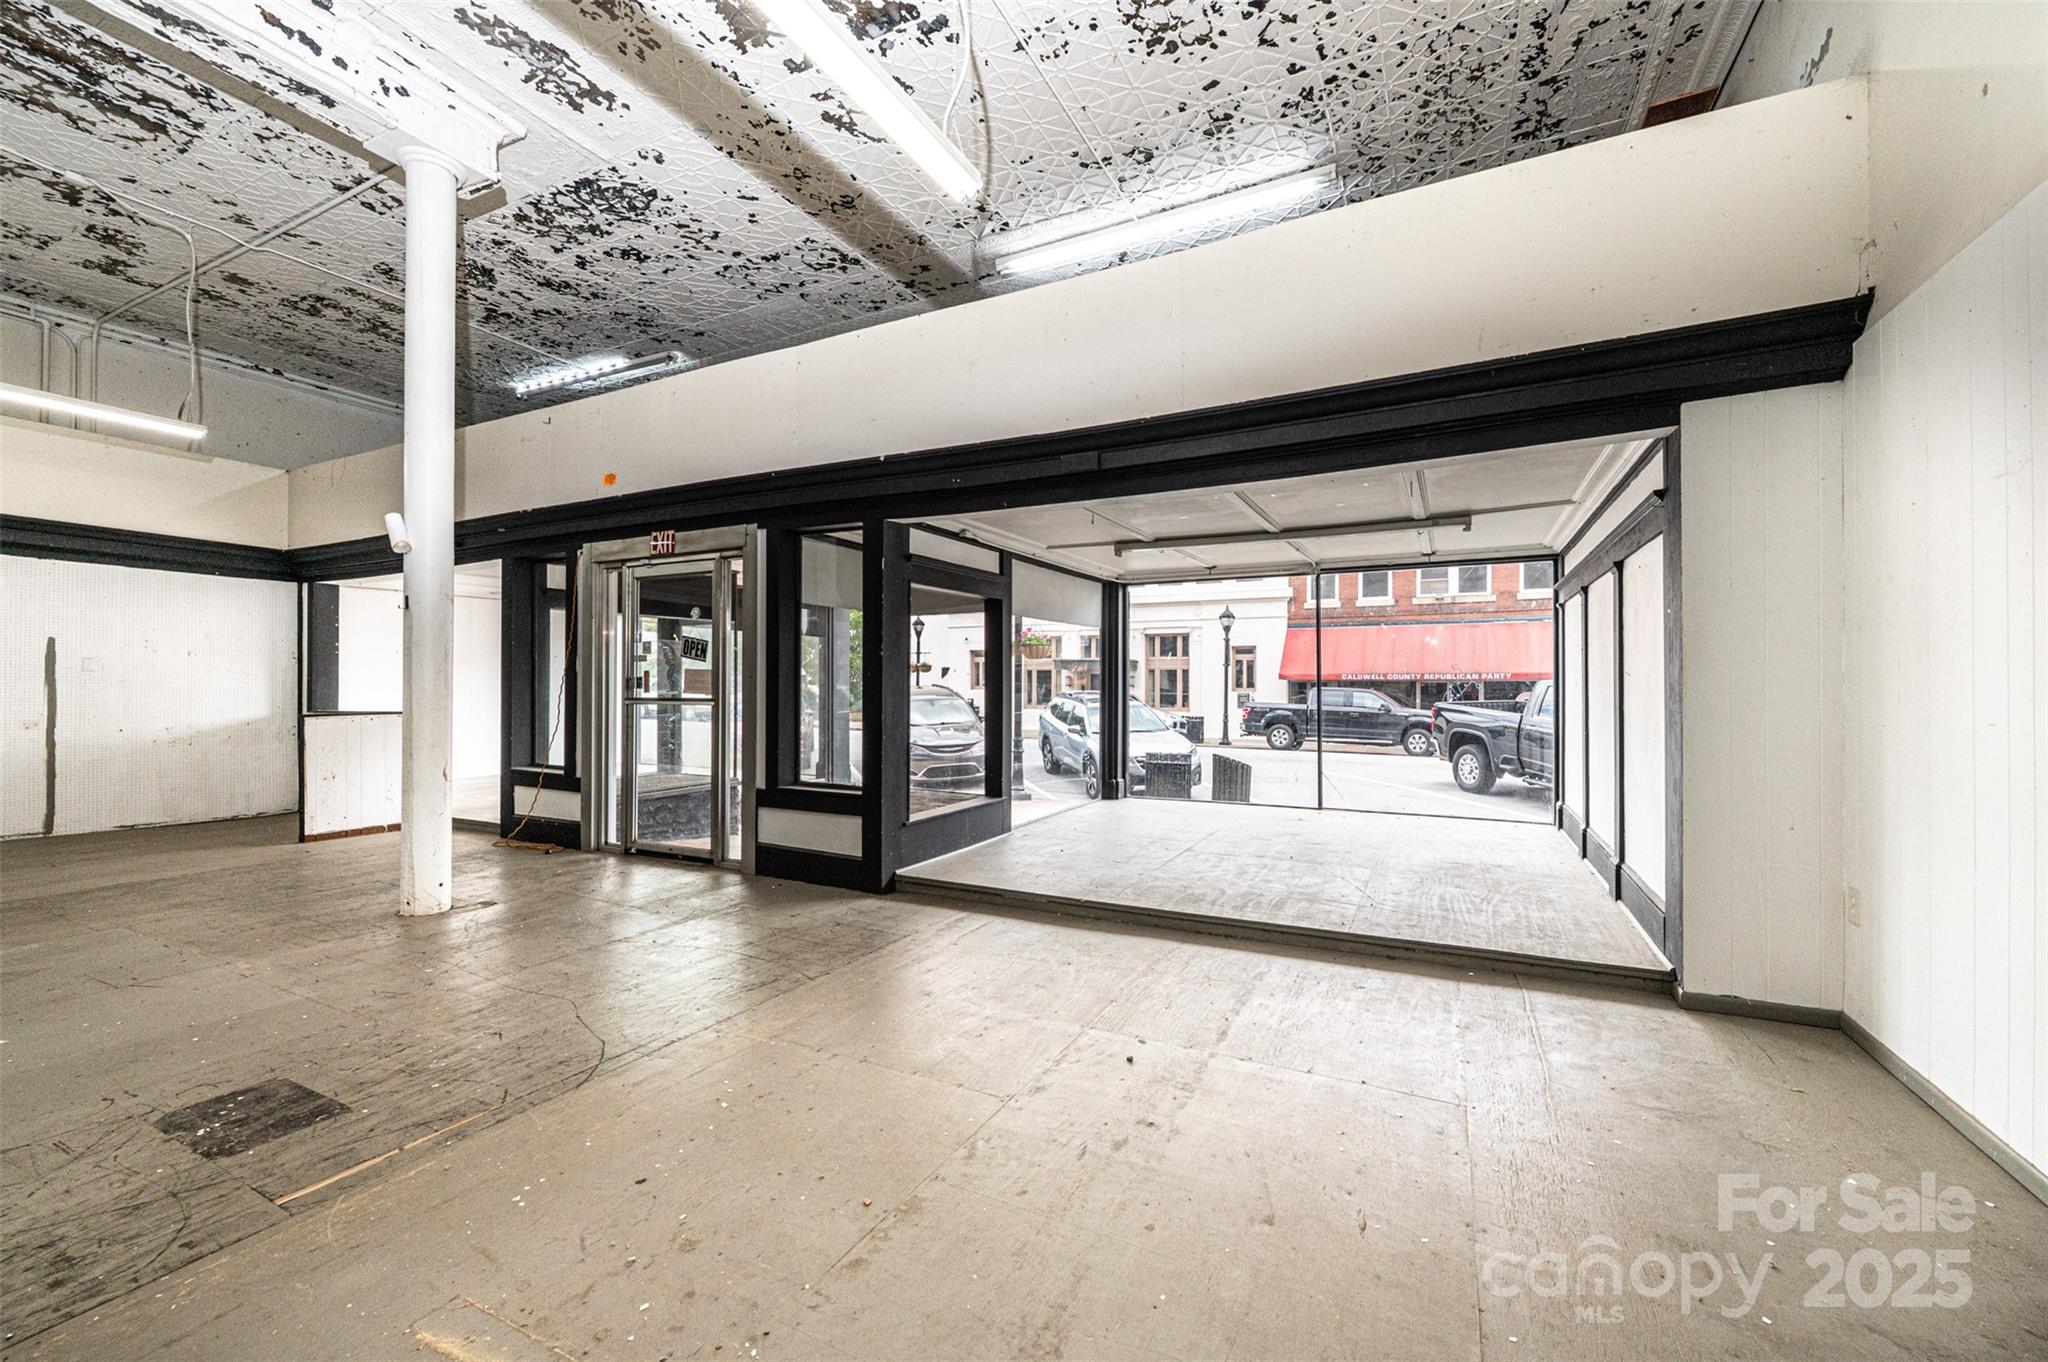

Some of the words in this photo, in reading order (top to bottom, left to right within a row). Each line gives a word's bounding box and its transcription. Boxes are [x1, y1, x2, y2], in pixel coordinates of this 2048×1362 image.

[650, 530, 674, 554] EXIT
[683, 639, 707, 659] OPEN
[1482, 672, 1512, 680] PARTY
